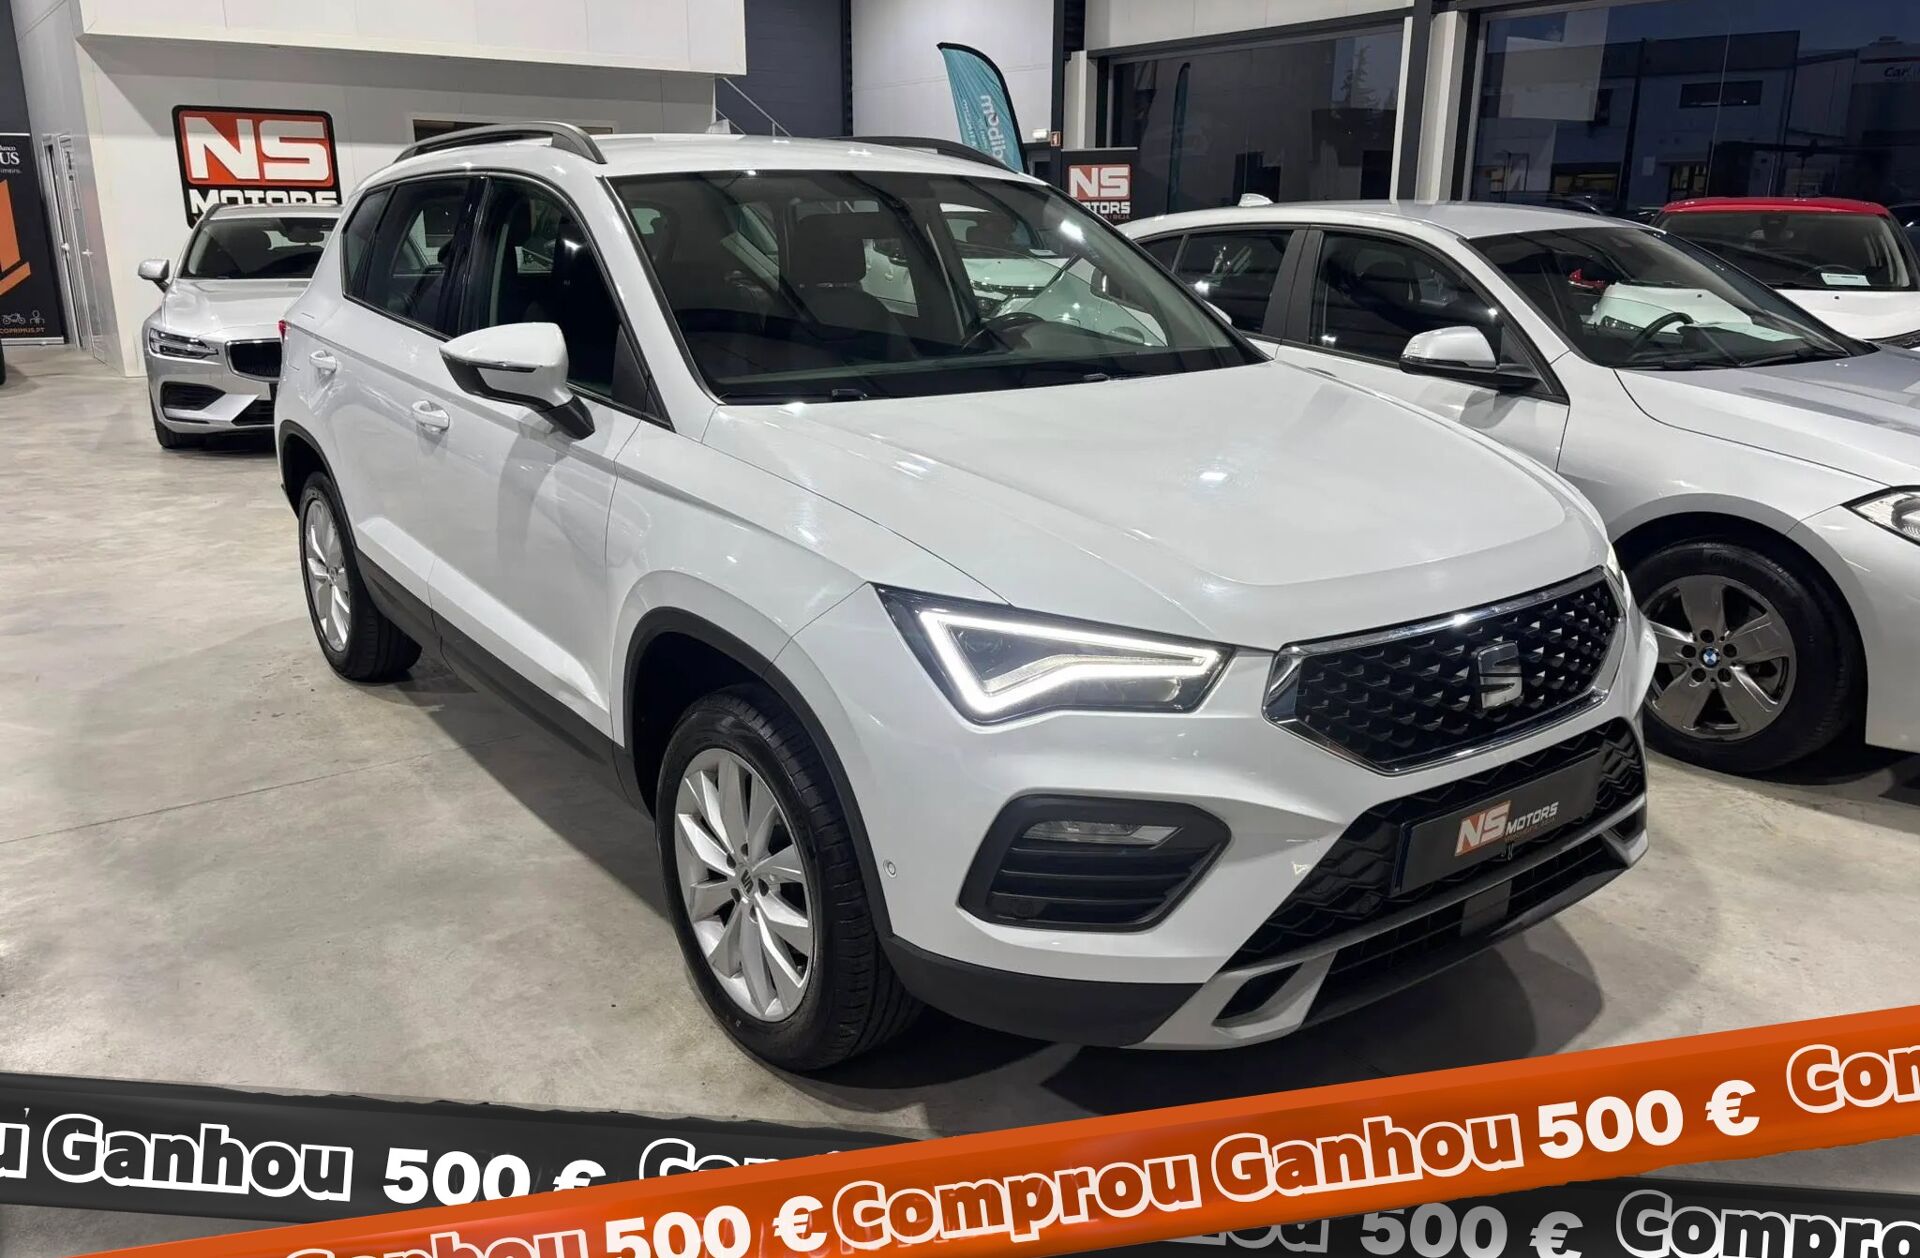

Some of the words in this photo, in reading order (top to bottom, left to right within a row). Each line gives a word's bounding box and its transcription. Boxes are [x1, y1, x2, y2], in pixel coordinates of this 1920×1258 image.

[182, 116, 330, 181] NS
[980, 94, 1007, 163] modib
[1069, 167, 1130, 198] NS
[1456, 802, 1511, 856] NS
[1505, 801, 1559, 836] MOTORS
